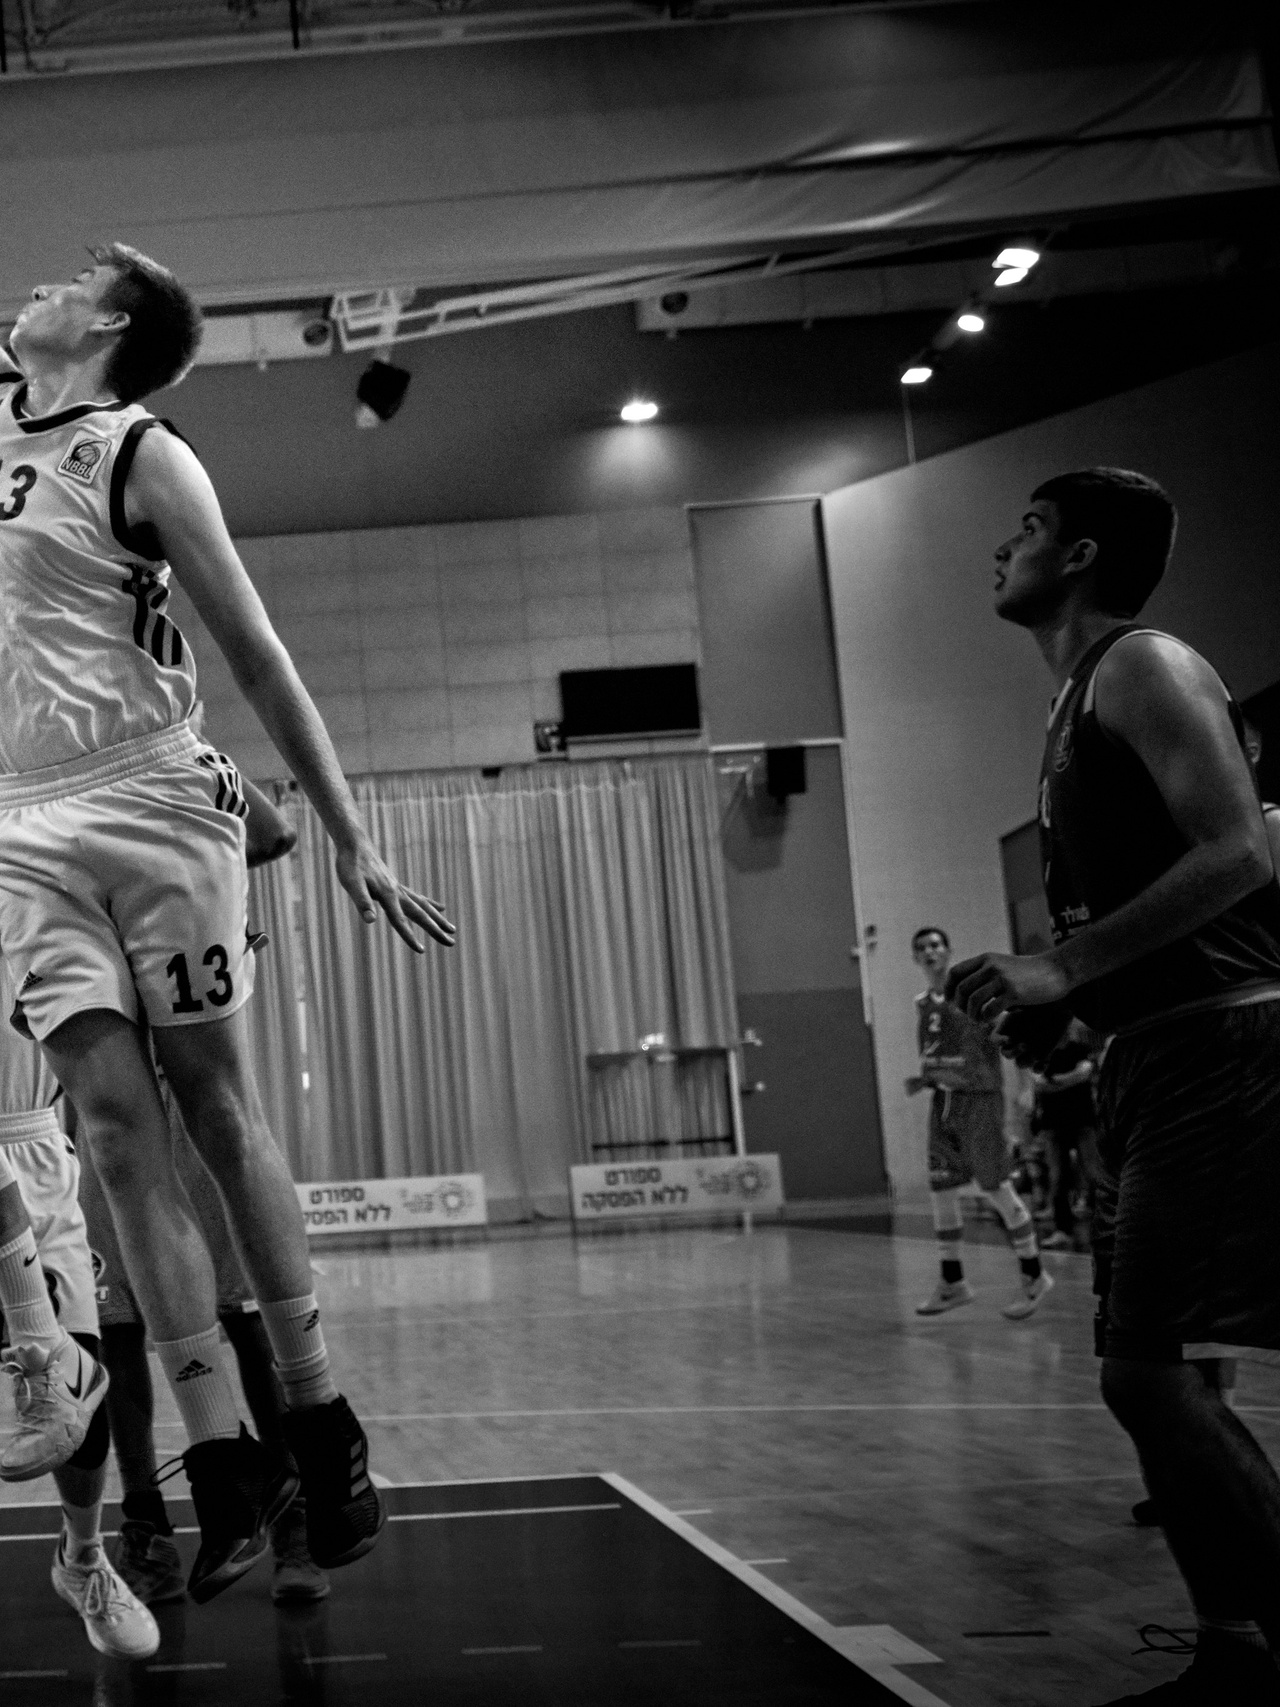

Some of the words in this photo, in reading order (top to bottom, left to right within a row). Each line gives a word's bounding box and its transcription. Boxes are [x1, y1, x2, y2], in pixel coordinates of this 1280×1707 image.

[61, 457, 94, 479] NBBL
[166, 944, 234, 1014] 13
[927, 1012, 942, 1033] 2
[605, 1167, 662, 1186] ספורט
[309, 1187, 365, 1205] ספורט
[581, 1190, 646, 1212] הפסקה
[651, 1186, 689, 1205] ללא
[303, 1209, 349, 1226] הפסק
[354, 1203, 391, 1222] ללא
